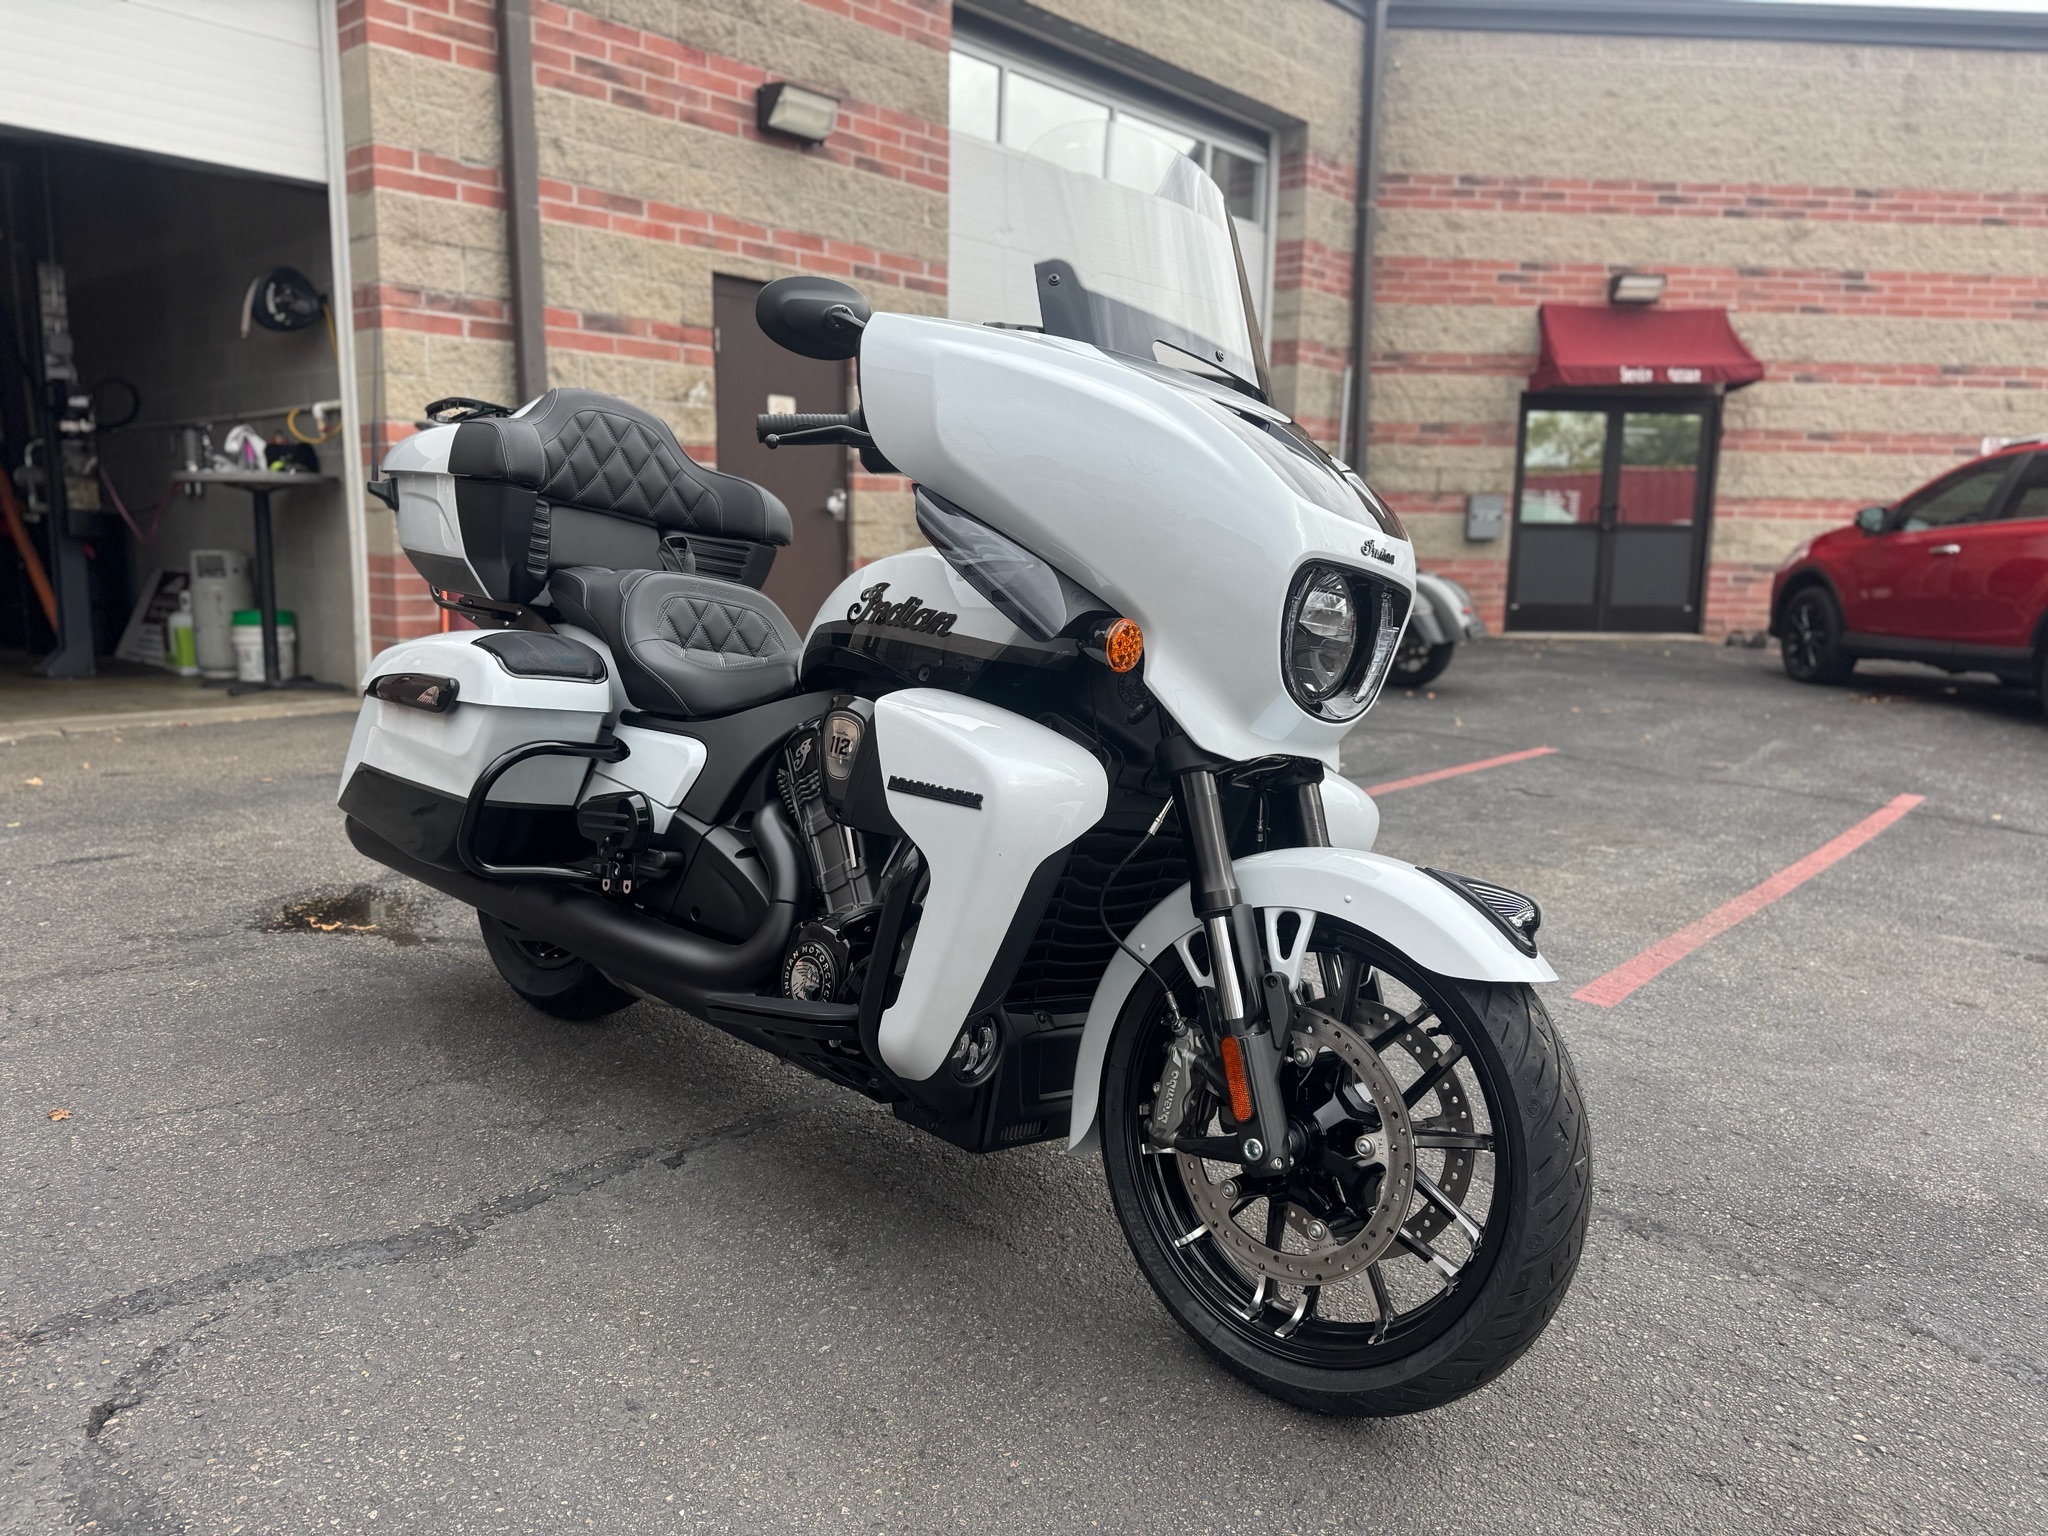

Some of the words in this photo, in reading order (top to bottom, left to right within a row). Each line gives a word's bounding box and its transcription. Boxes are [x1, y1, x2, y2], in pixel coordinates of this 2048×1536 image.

[1360, 539, 1395, 565] Indian
[847, 582, 958, 637] Indian
[830, 735, 851, 756] 112
[784, 950, 799, 996] INDIAN
[1157, 1070, 1180, 1124] brembo
